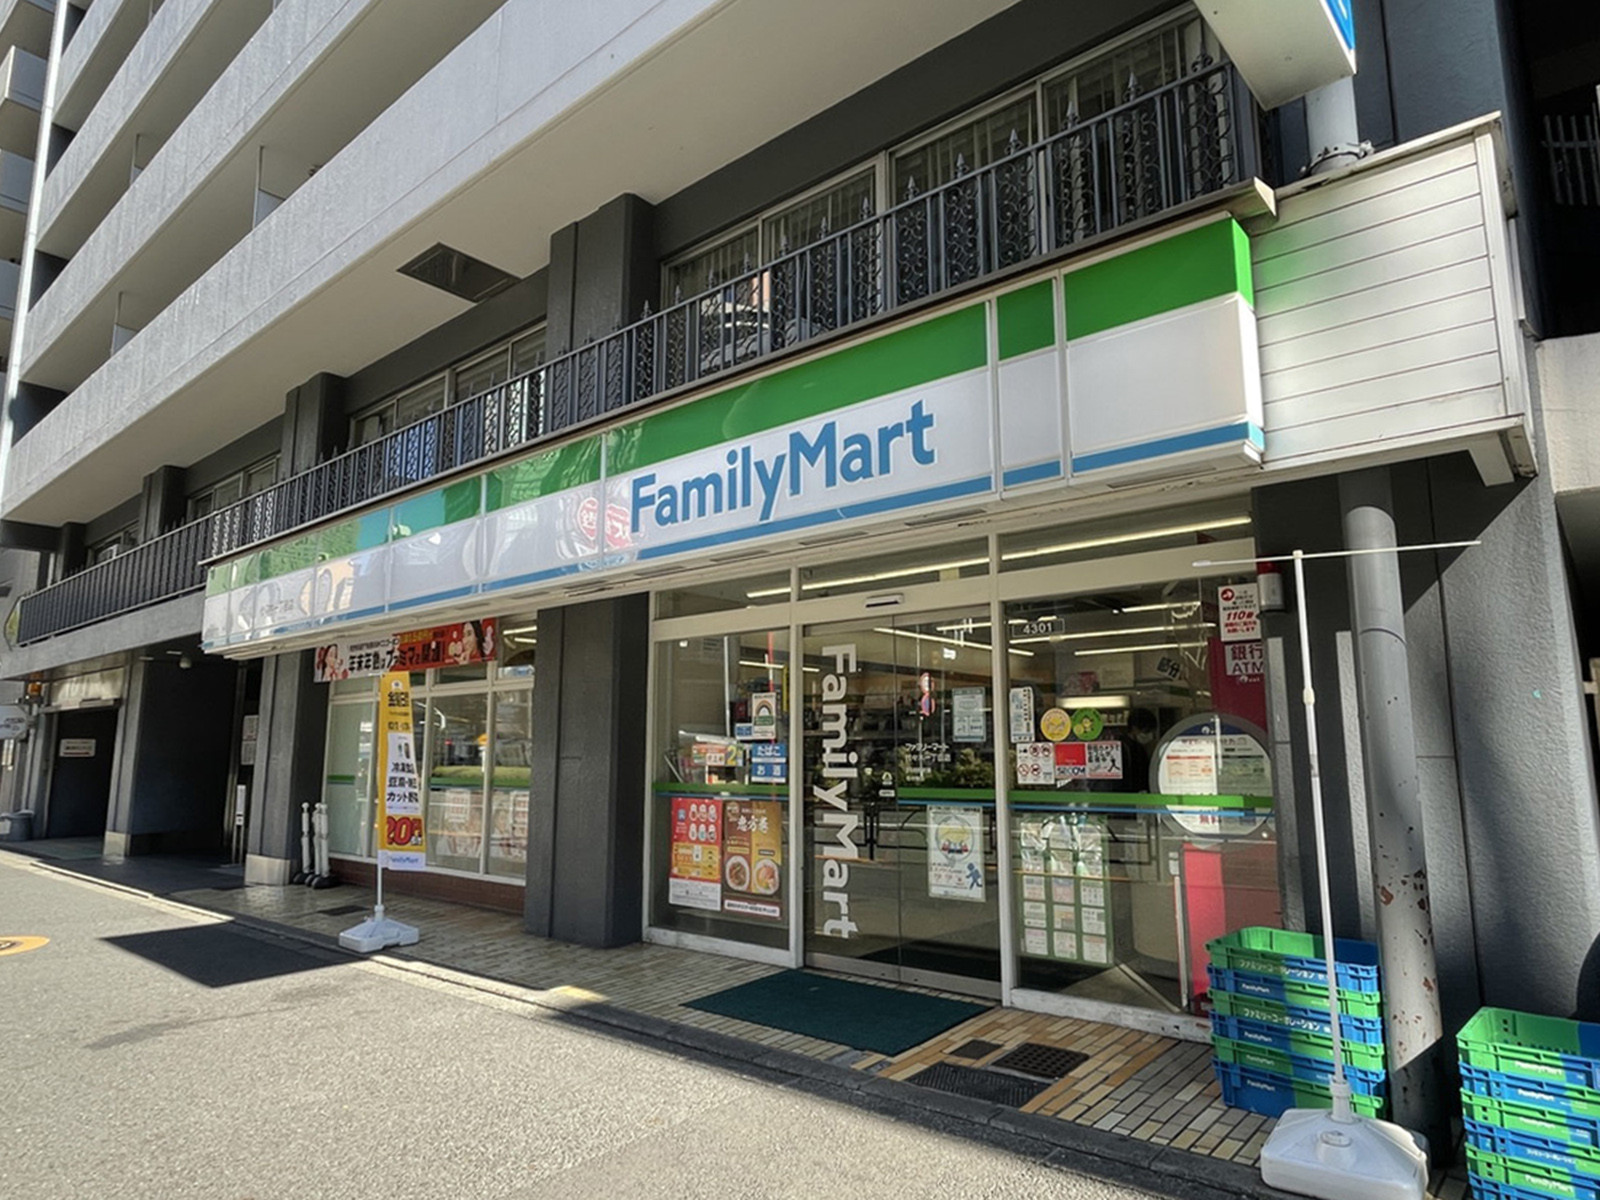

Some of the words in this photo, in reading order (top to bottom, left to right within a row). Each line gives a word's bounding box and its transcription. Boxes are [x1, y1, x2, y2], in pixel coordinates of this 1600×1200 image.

[631, 400, 935, 533] FamilyMart
[1023, 622, 1052, 635] 4301
[1231, 643, 1263, 660] 銀行
[1232, 661, 1264, 675] ATM
[757, 745, 781, 756] たばこ
[1057, 766, 1086, 775] SECOM
[813, 643, 859, 939] FamilyMart
[1242, 983, 1270, 993] FamilyMart
[1244, 1031, 1273, 1043] FamilyMart
